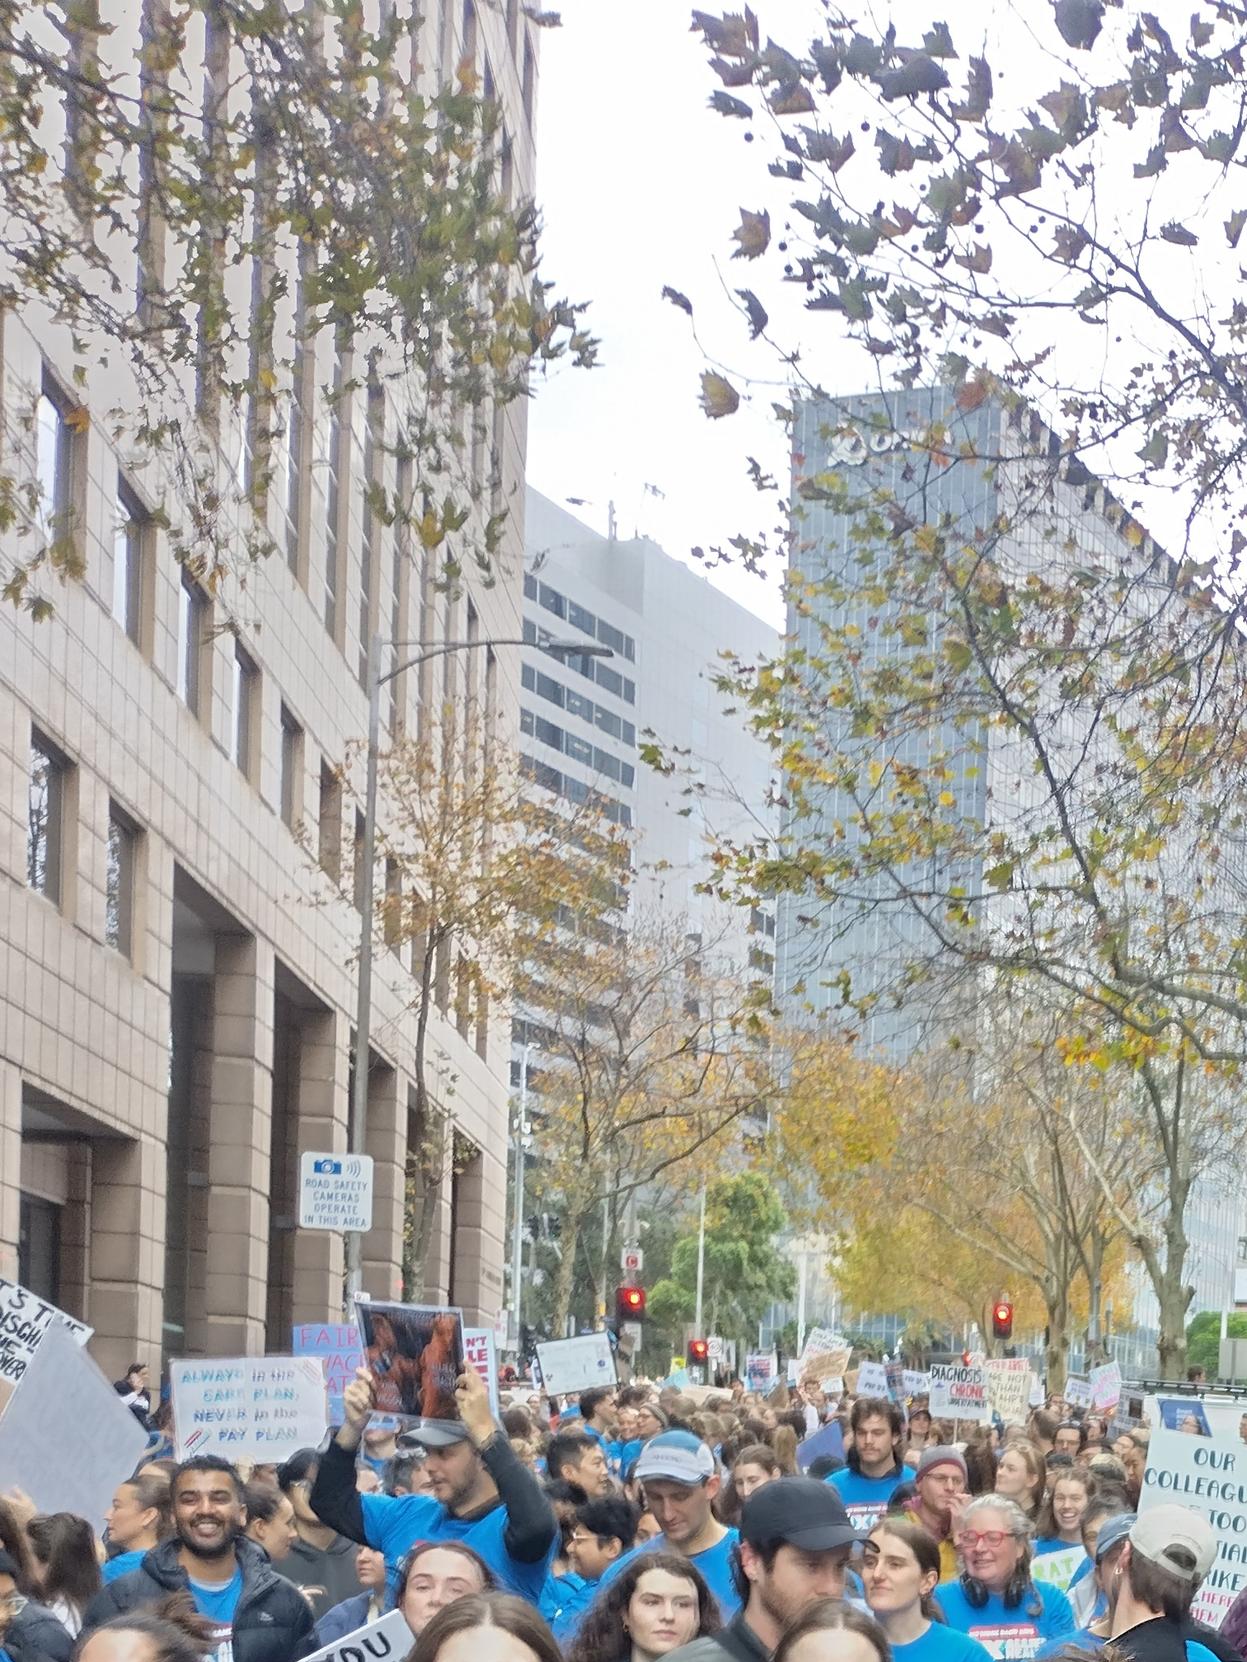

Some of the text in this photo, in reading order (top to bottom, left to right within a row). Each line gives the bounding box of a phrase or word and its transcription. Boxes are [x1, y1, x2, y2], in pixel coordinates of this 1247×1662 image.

[305, 1178, 368, 1192] ROAD SAFETY
[312, 1190, 360, 1204] CAMERAS
[314, 1203, 358, 1216] OPERATE
[304, 1214, 367, 1228] IN THIS AREA
[300, 1327, 358, 1348] FAIR
[194, 1408, 247, 1423] NEVER
[218, 1427, 298, 1442] PAY PLAN
[1194, 1447, 1237, 1472] OUR
[1208, 1509, 1247, 1533] TOO
